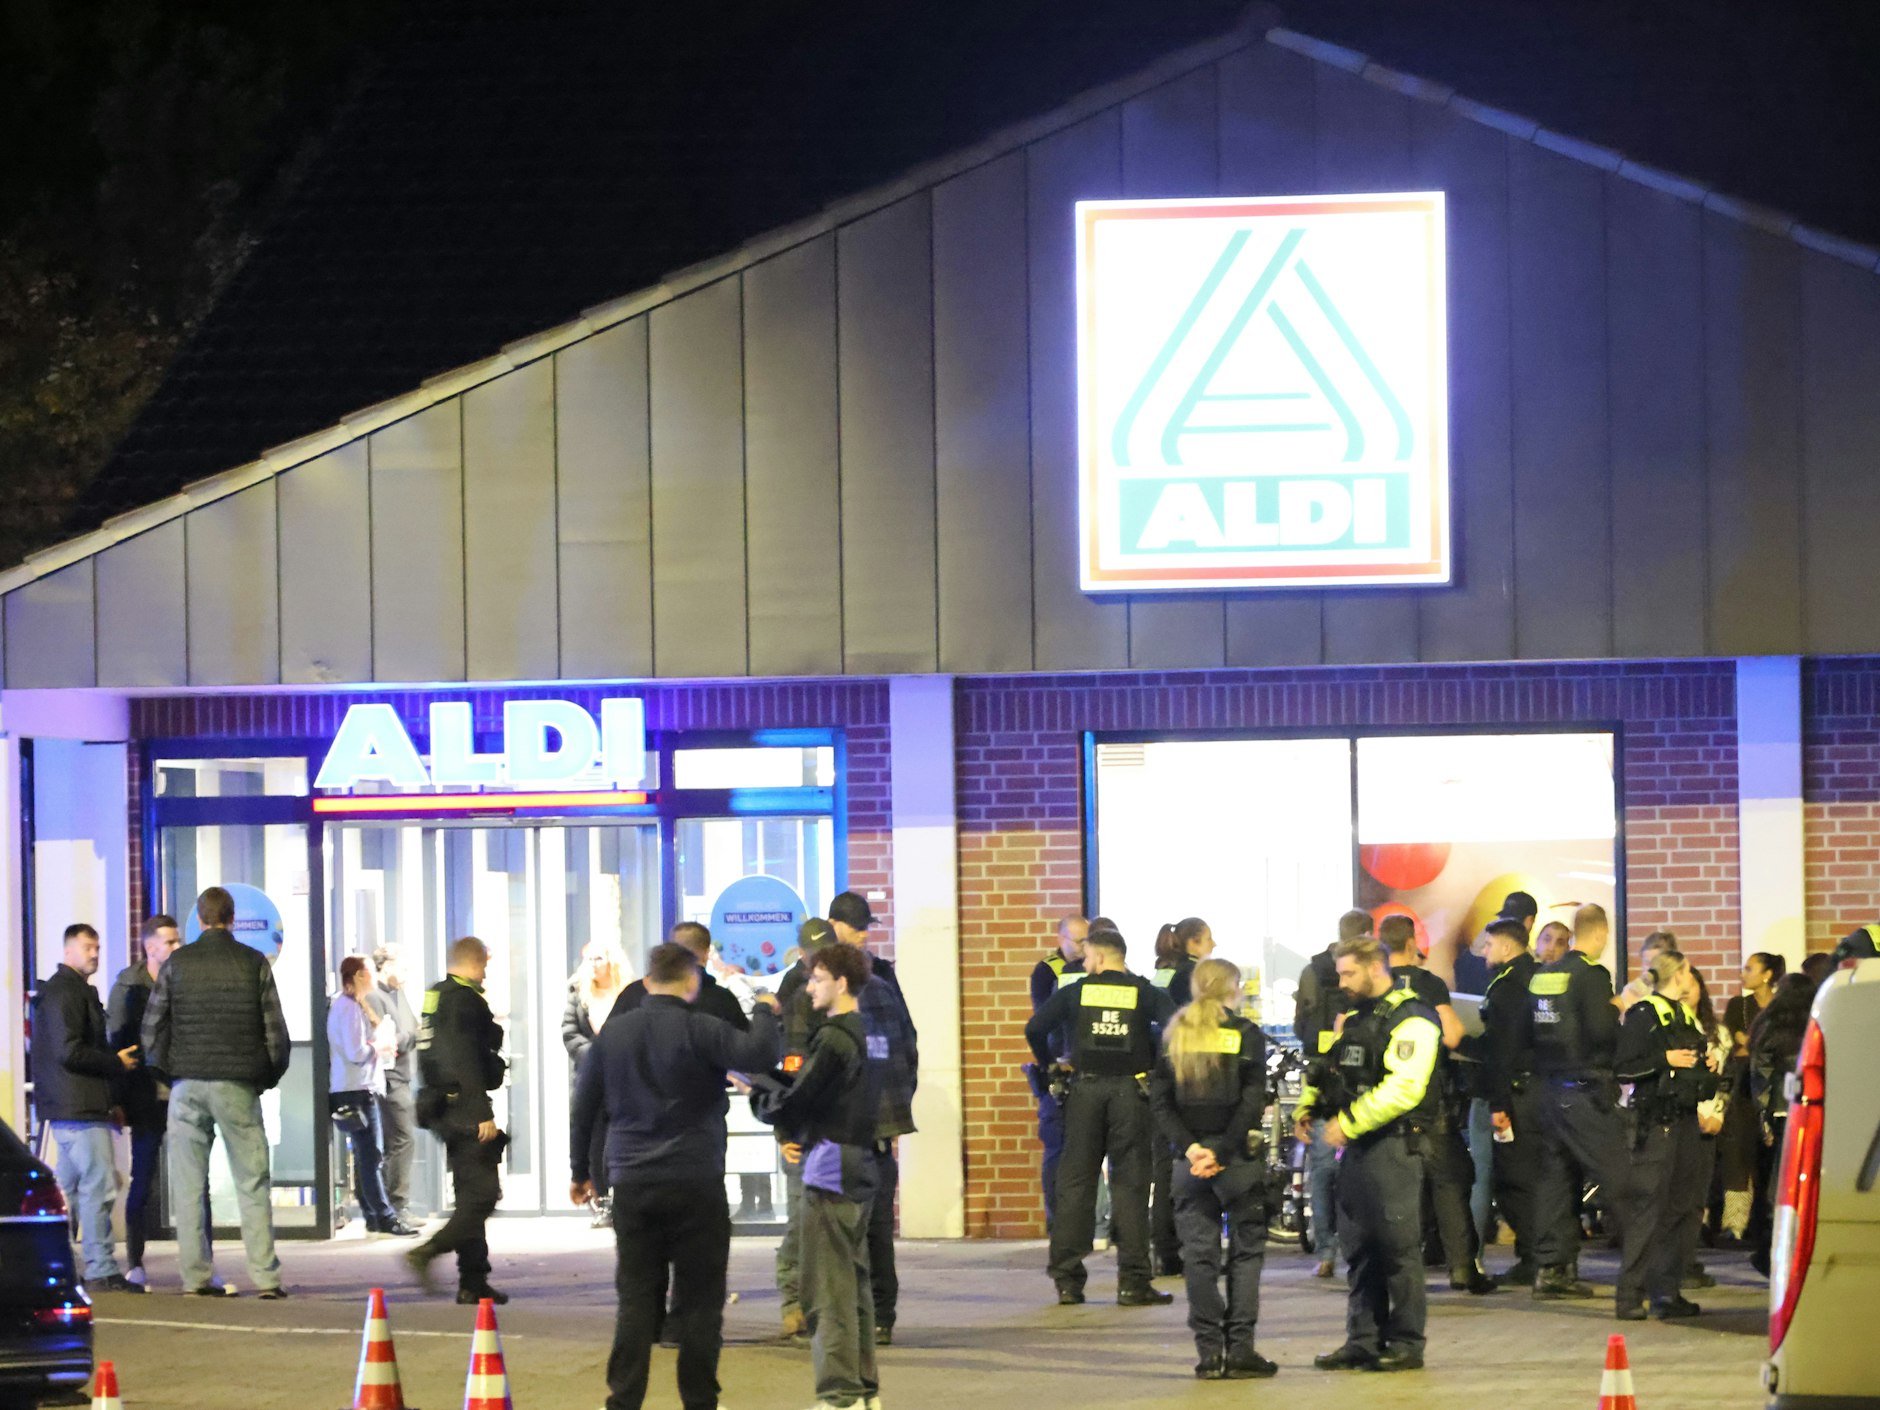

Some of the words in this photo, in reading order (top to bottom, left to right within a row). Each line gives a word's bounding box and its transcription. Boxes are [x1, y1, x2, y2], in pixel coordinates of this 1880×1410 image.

[1136, 478, 1387, 550] ALDI
[313, 697, 646, 789] ALDI
[1091, 1022, 1129, 1036] 35214
[1102, 1010, 1120, 1023] BE
